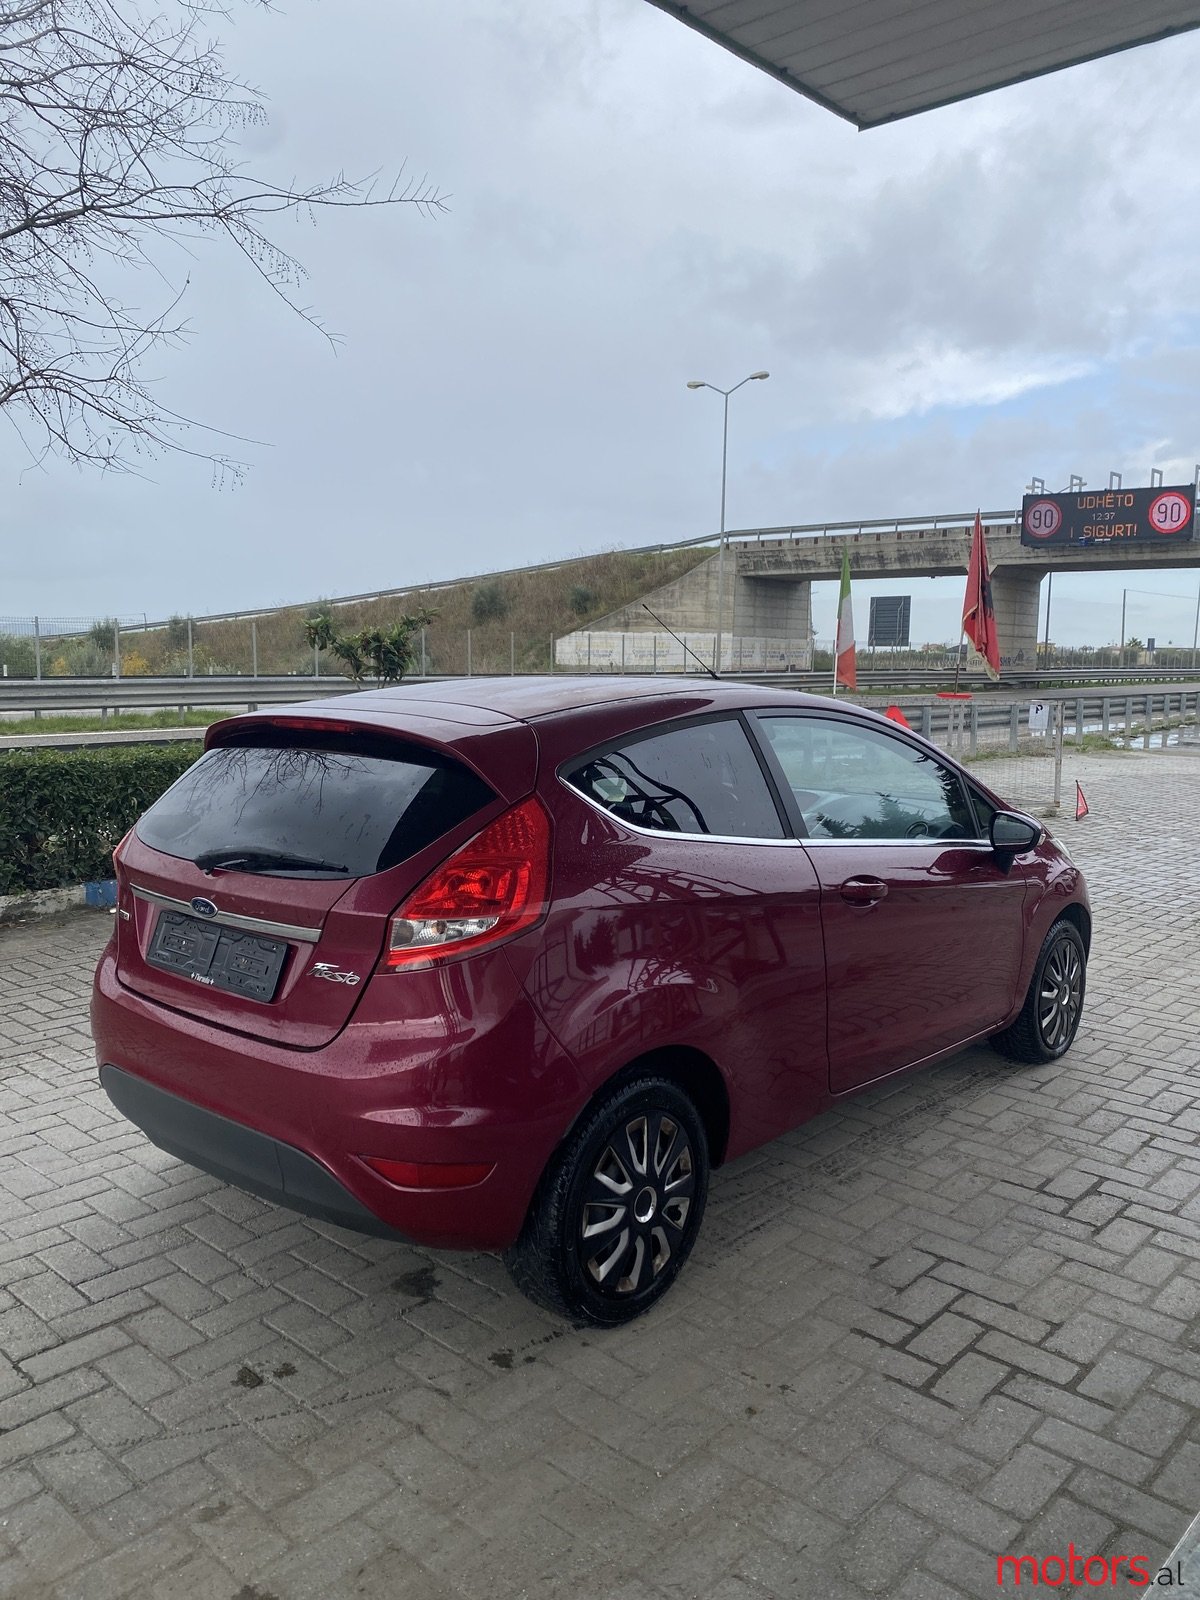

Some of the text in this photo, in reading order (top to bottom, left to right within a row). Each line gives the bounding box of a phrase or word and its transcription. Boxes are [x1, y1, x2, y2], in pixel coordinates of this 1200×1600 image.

[1077, 494, 1133, 509] UDHËTO
[1032, 509, 1054, 529] 90
[1157, 502, 1181, 523] 90
[1083, 524, 1137, 537] SIGURT!
[307, 962, 360, 985] Fiesta
